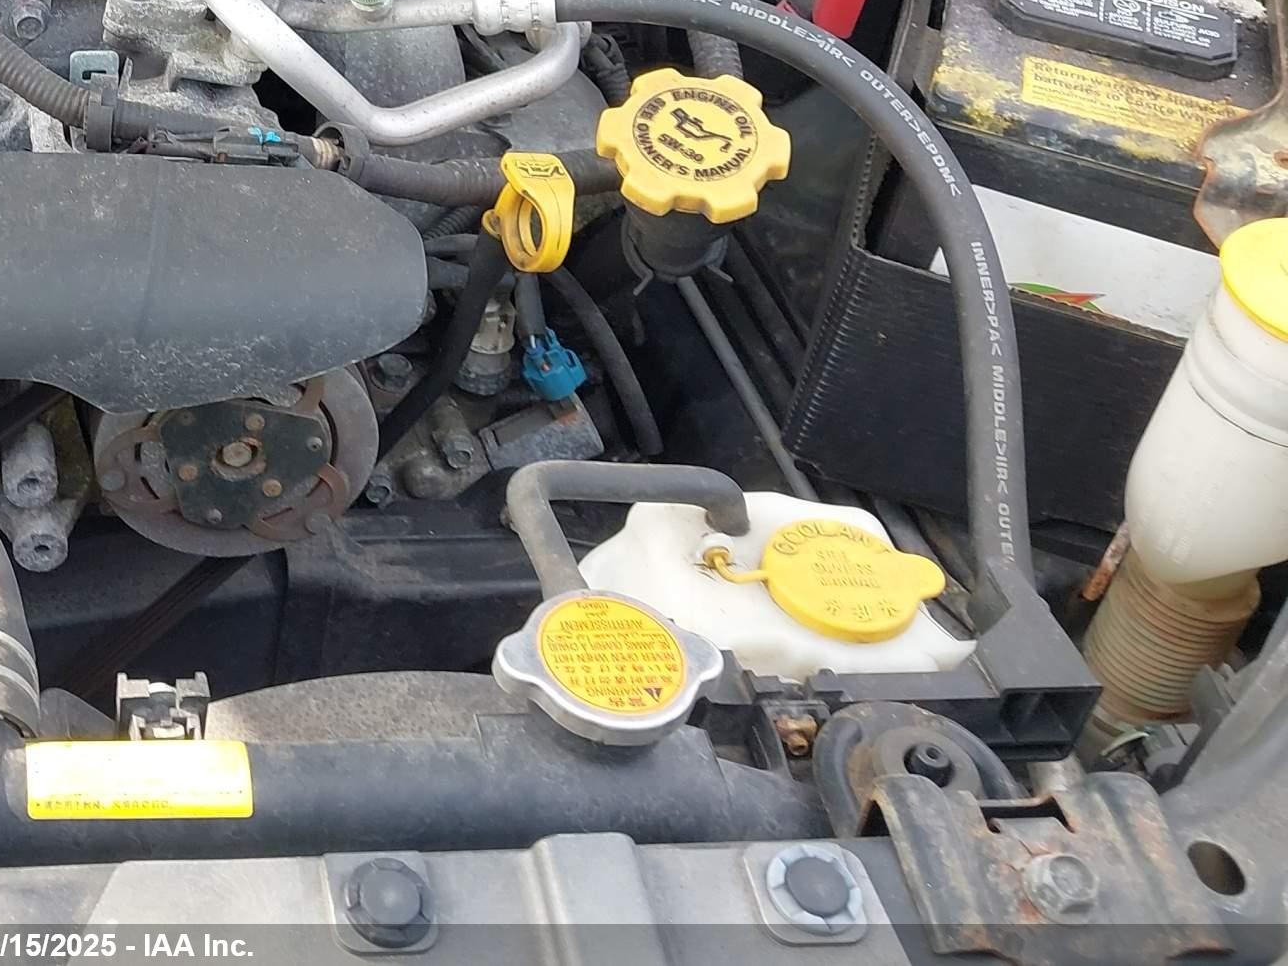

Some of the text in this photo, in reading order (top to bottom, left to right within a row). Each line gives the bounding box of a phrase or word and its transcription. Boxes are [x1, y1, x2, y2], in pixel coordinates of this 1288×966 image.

[1034, 62, 1086, 81] Return
[672, 90, 754, 140] ENGINE OIL
[636, 97, 752, 178] SEE OWNER'S MANUAL
[657, 134, 705, 164] 5W-30
[559, 620, 642, 631] AVERTISSEMENT
[577, 651, 608, 661] WHEN
[610, 651, 637, 661] OPEN
[642, 651, 675, 661] NEVER
[584, 686, 641, 696] WARNING
